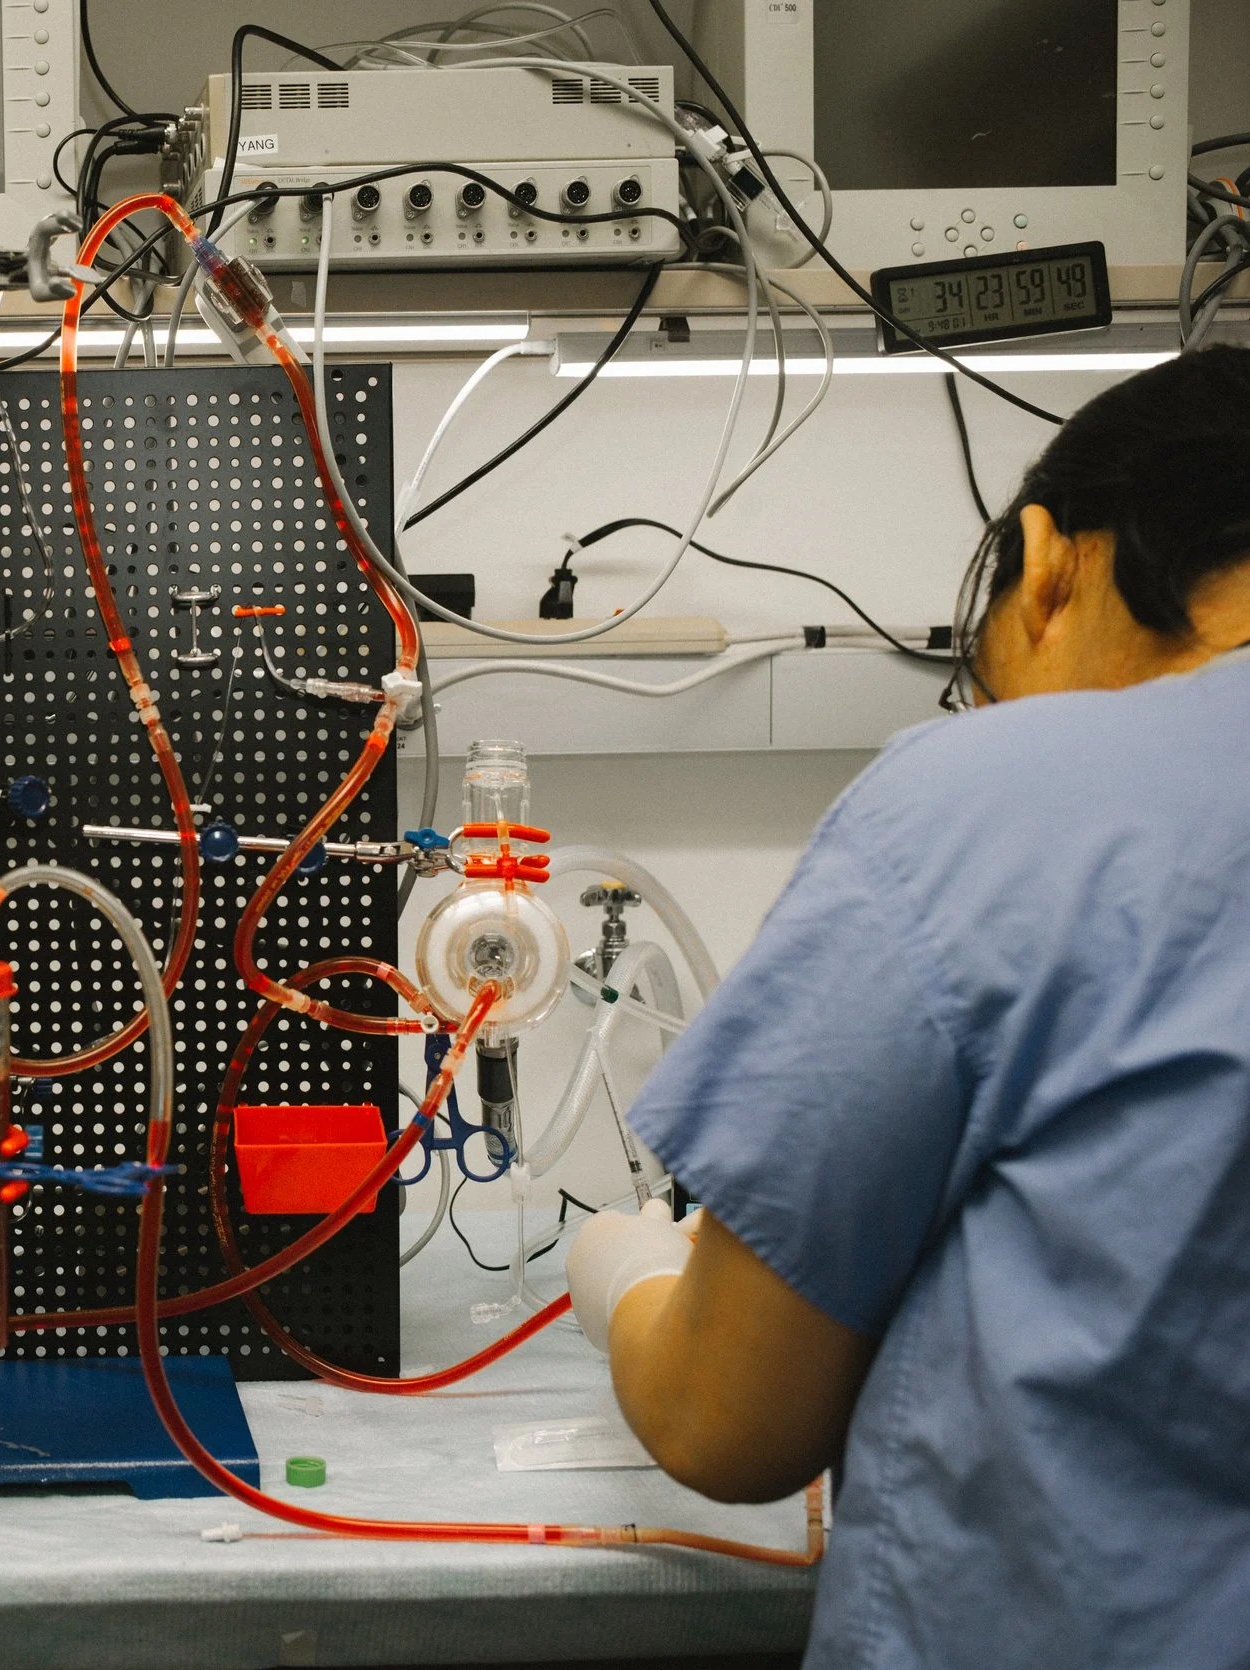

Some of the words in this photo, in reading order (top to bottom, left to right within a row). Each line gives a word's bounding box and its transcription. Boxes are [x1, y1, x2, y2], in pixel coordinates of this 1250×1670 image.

[784, 3, 797, 12] 500
[238, 138, 275, 152] YANG
[1015, 267, 1046, 306] 59
[1056, 262, 1087, 298] 49
[933, 279, 965, 314] 34
[975, 273, 1005, 310] 23
[1023, 306, 1044, 317] MIN
[1063, 302, 1086, 312] SEC
[983, 312, 1000, 323] HR
